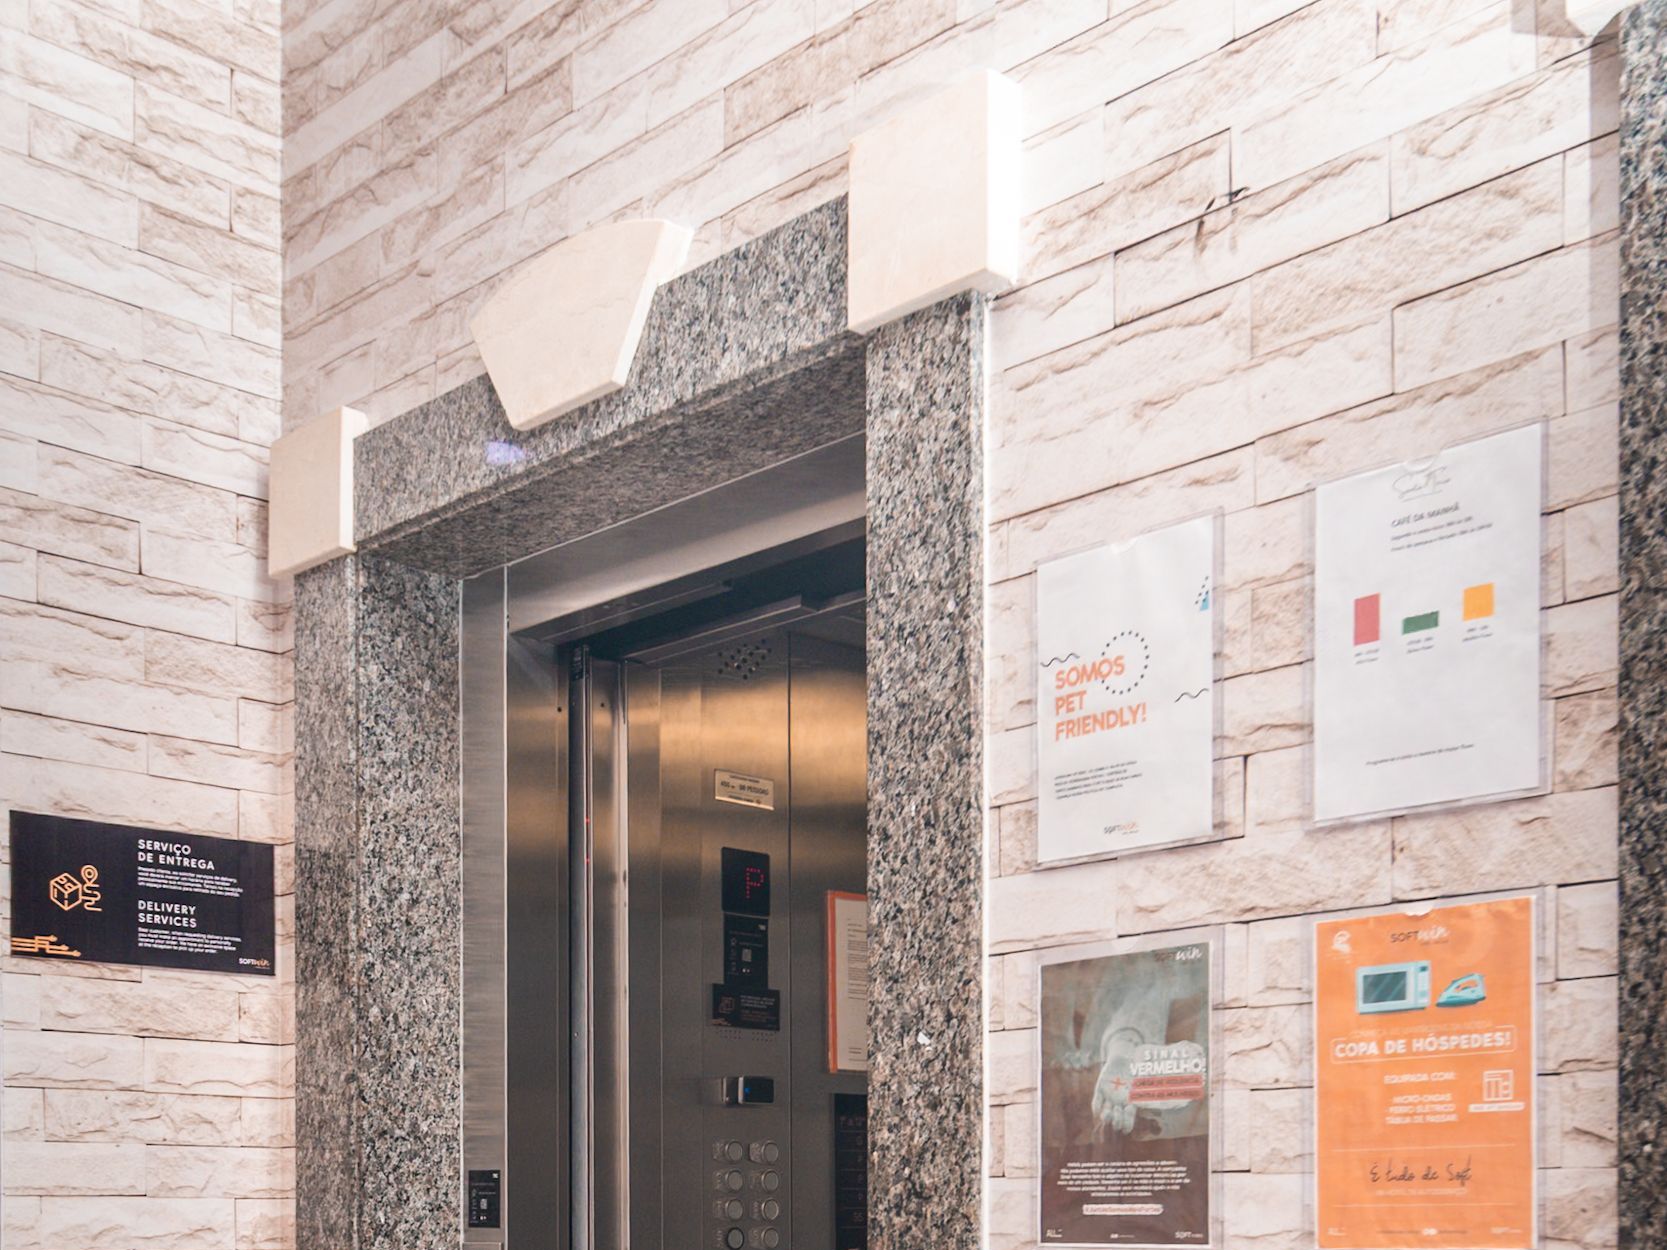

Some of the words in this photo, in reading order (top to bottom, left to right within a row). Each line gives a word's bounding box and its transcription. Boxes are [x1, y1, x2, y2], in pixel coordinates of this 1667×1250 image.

[1055, 655, 1125, 690] SOMOS
[1055, 690, 1087, 717] PET
[1055, 702, 1148, 742] FRIENDLY!
[138, 839, 192, 857] SERVIÇO
[138, 851, 154, 863] DE
[159, 854, 215, 871] ENTREGA
[745, 866, 765, 899] P
[138, 900, 196, 915] DELIVERY
[138, 913, 197, 929] SERVICES
[1144, 1048, 1189, 1061] SINAL
[1334, 1040, 1380, 1058] COPA
[1384, 1039, 1407, 1055] DE
[1412, 1031, 1512, 1053] HÓSPEDES!
[1130, 1056, 1207, 1076] VERMELHO!
[1422, 1166, 1439, 1181] de
